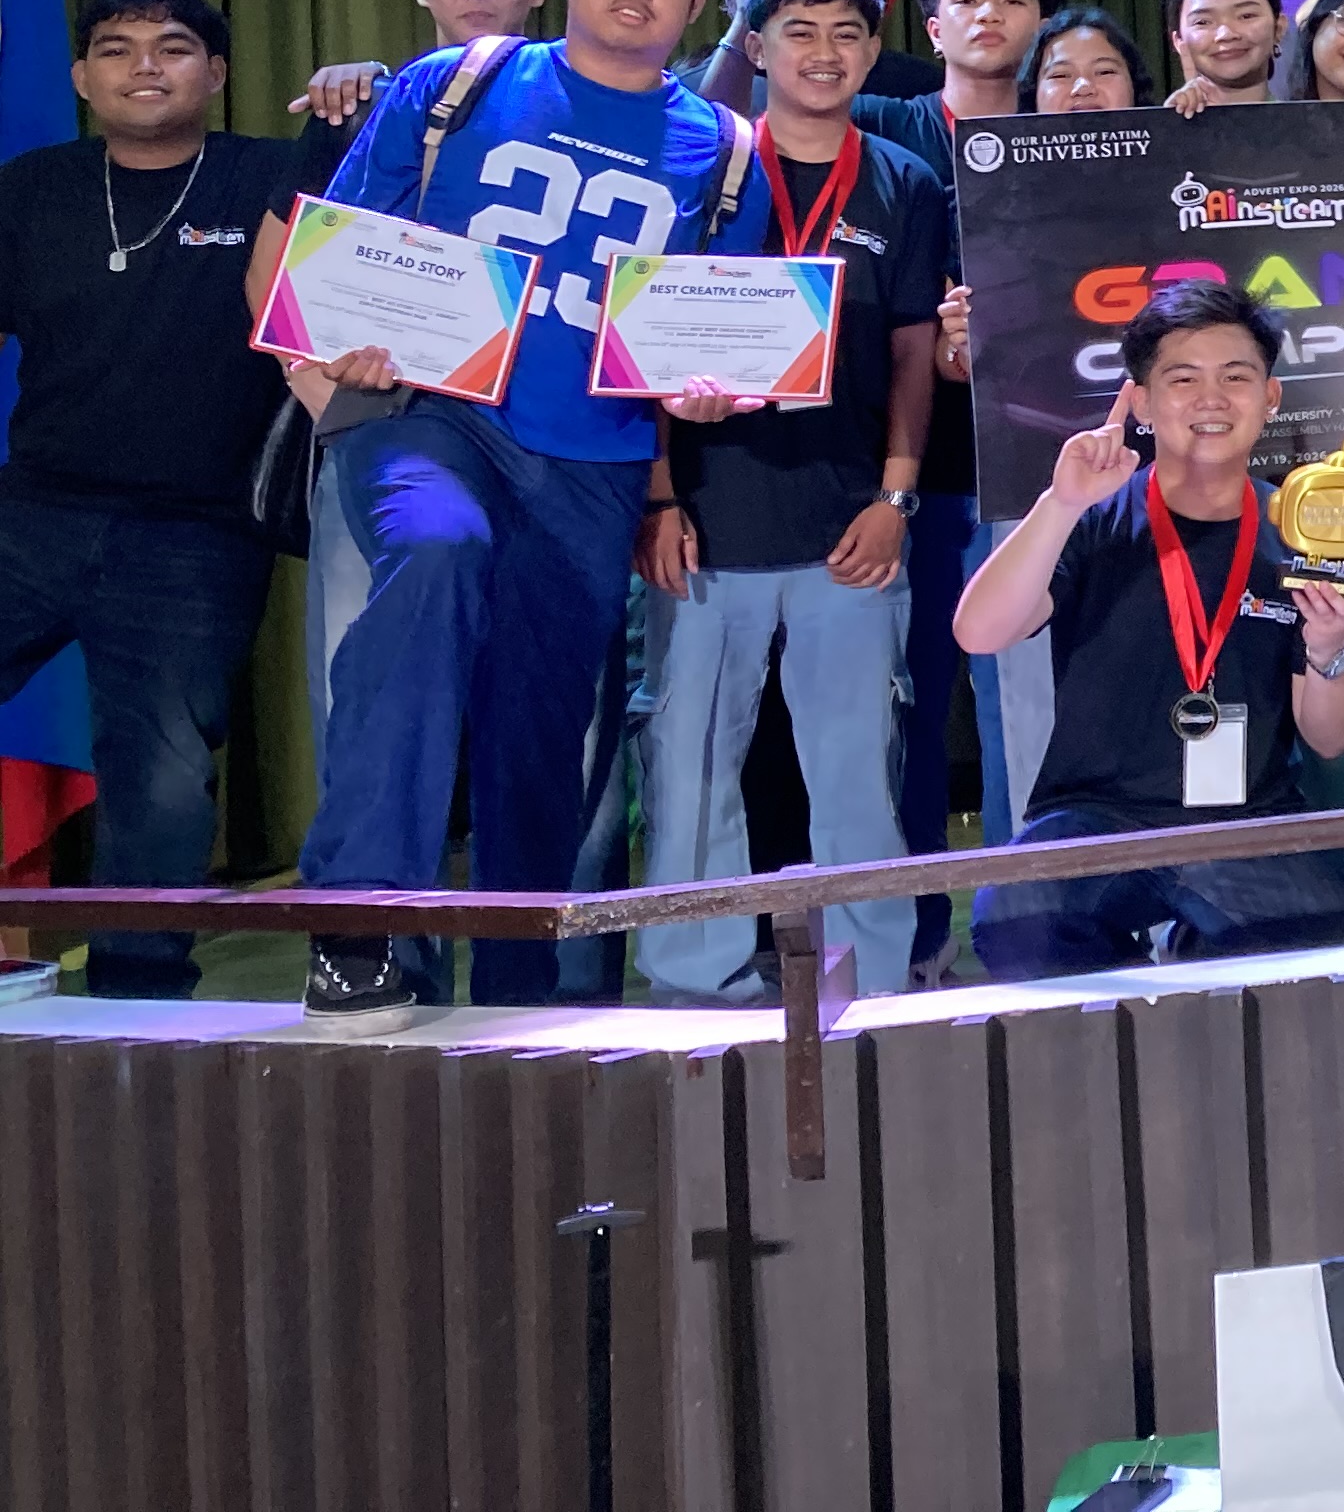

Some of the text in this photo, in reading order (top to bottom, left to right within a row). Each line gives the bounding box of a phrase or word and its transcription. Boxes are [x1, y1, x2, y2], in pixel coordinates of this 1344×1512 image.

[1011, 130, 1150, 146] OUR LADY OF FATIMA
[1013, 140, 1150, 163] UNIVERSITY
[1243, 184, 1344, 196] ADVERT EXPO 2026
[468, 140, 677, 334] 23
[355, 245, 392, 263] BEST
[393, 256, 415, 268] AD
[417, 261, 467, 281] STORY
[649, 284, 796, 299] BEST CREATIVE CONCEPT
[1272, 424, 1331, 437] ASSEMBLY
[1272, 454, 1291, 465] 19,
[1296, 450, 1327, 464] 2026
